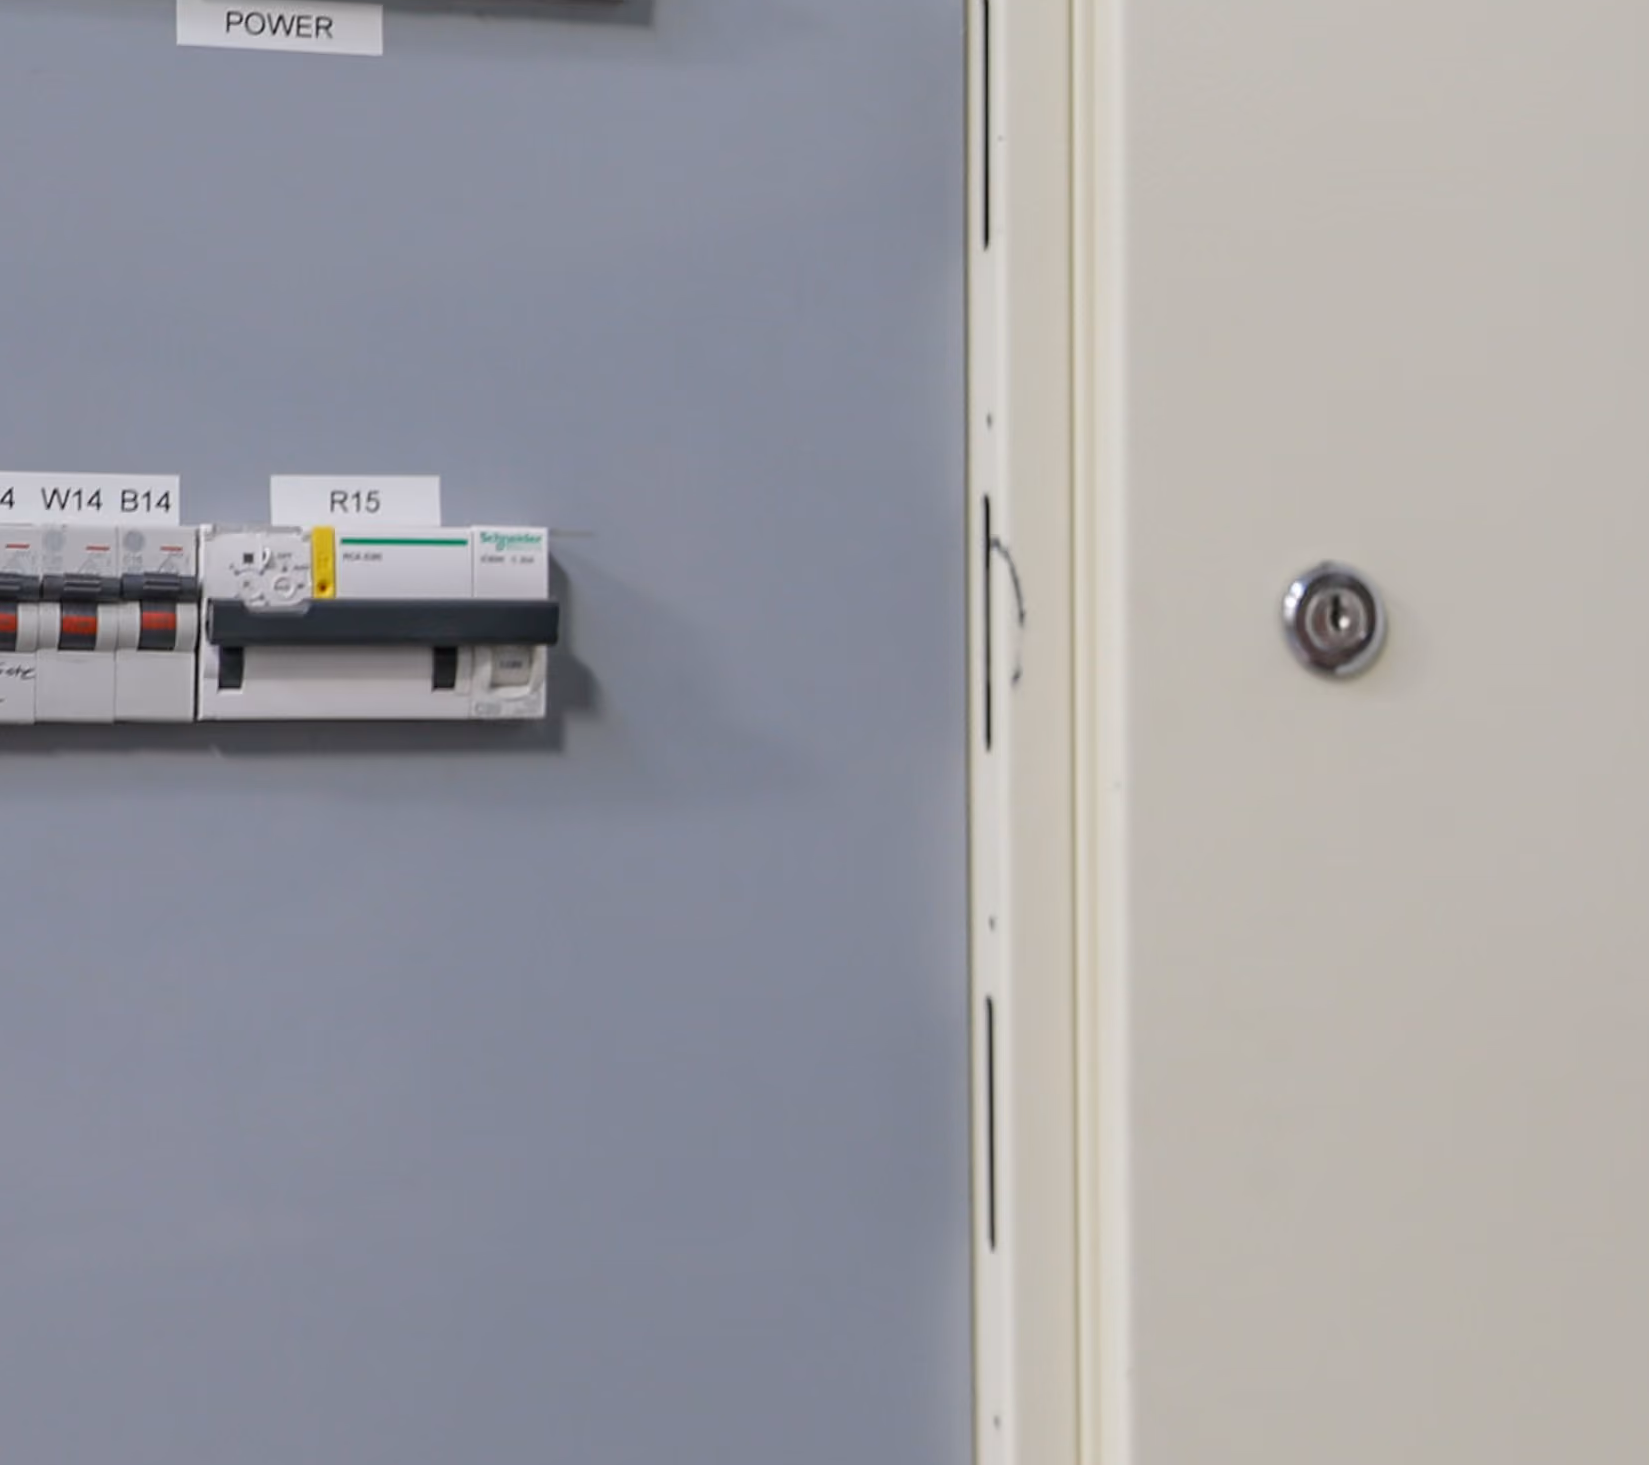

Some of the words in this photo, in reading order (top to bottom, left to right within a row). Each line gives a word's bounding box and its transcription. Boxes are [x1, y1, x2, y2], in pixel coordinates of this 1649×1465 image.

[225, 10, 334, 39] POWER
[41, 487, 102, 511] W14
[120, 489, 171, 513] B14
[330, 490, 381, 514] R15
[479, 531, 543, 551] Schneider
